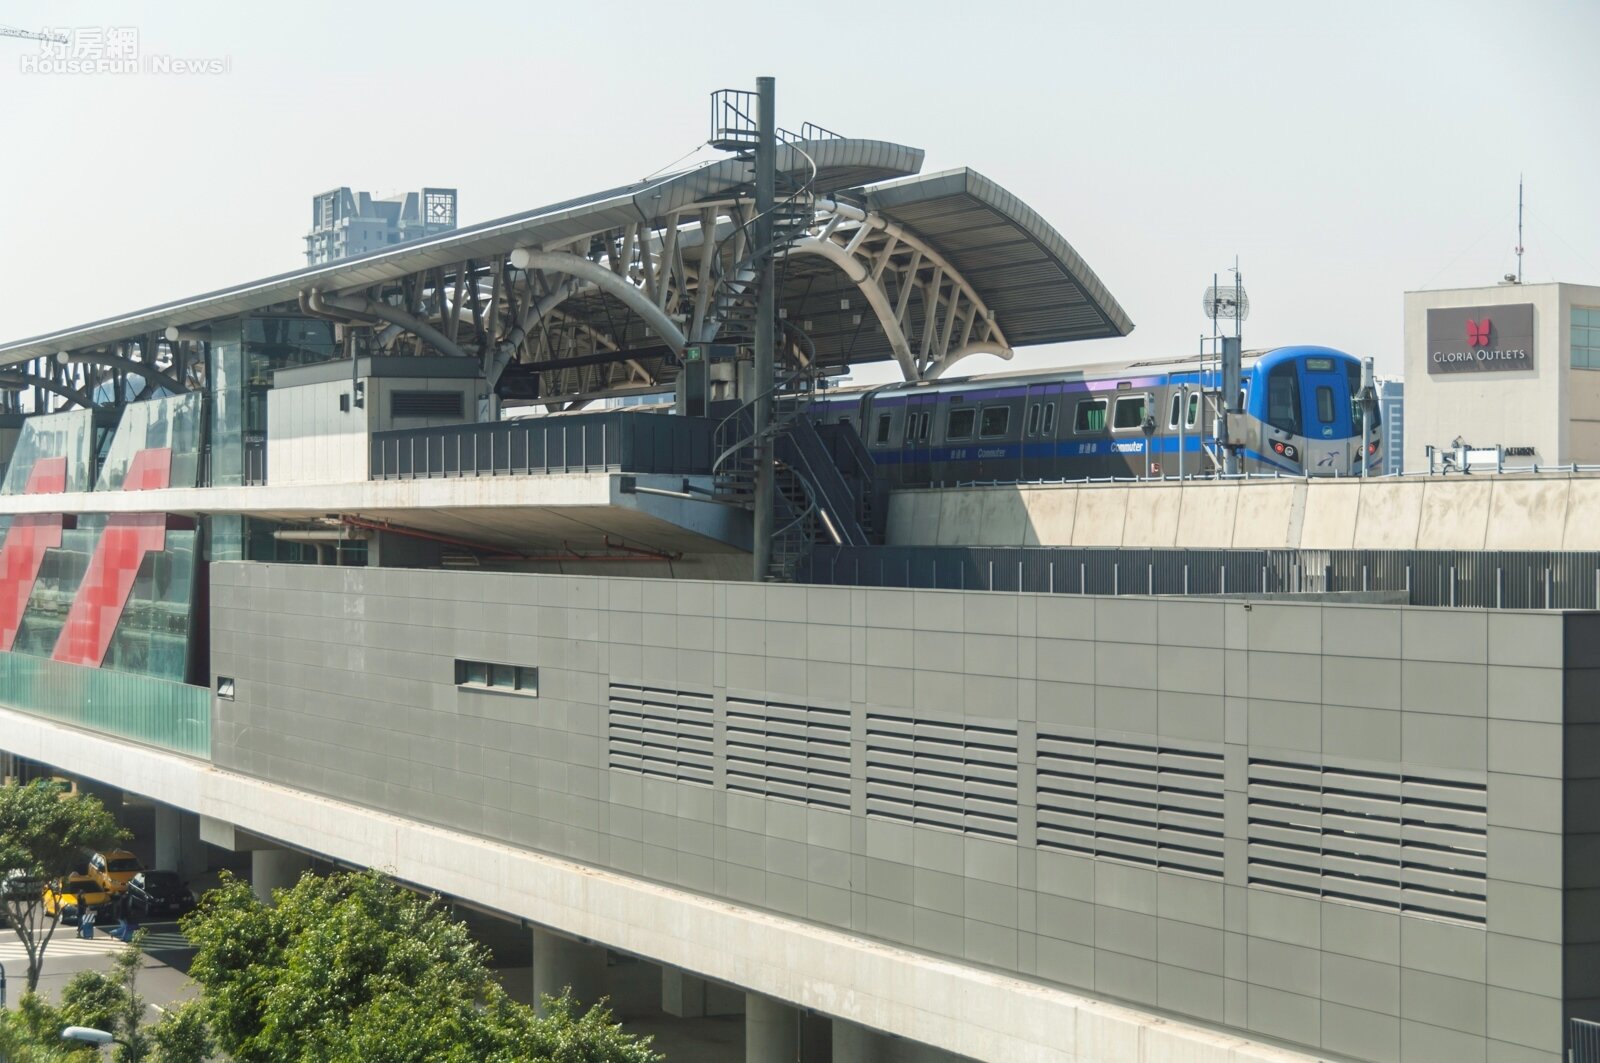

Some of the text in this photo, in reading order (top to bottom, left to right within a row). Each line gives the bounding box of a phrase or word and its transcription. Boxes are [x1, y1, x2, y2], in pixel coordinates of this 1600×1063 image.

[1433, 349, 1525, 363] GLORIA OUTLETS
[1110, 441, 1144, 453] Commuter
